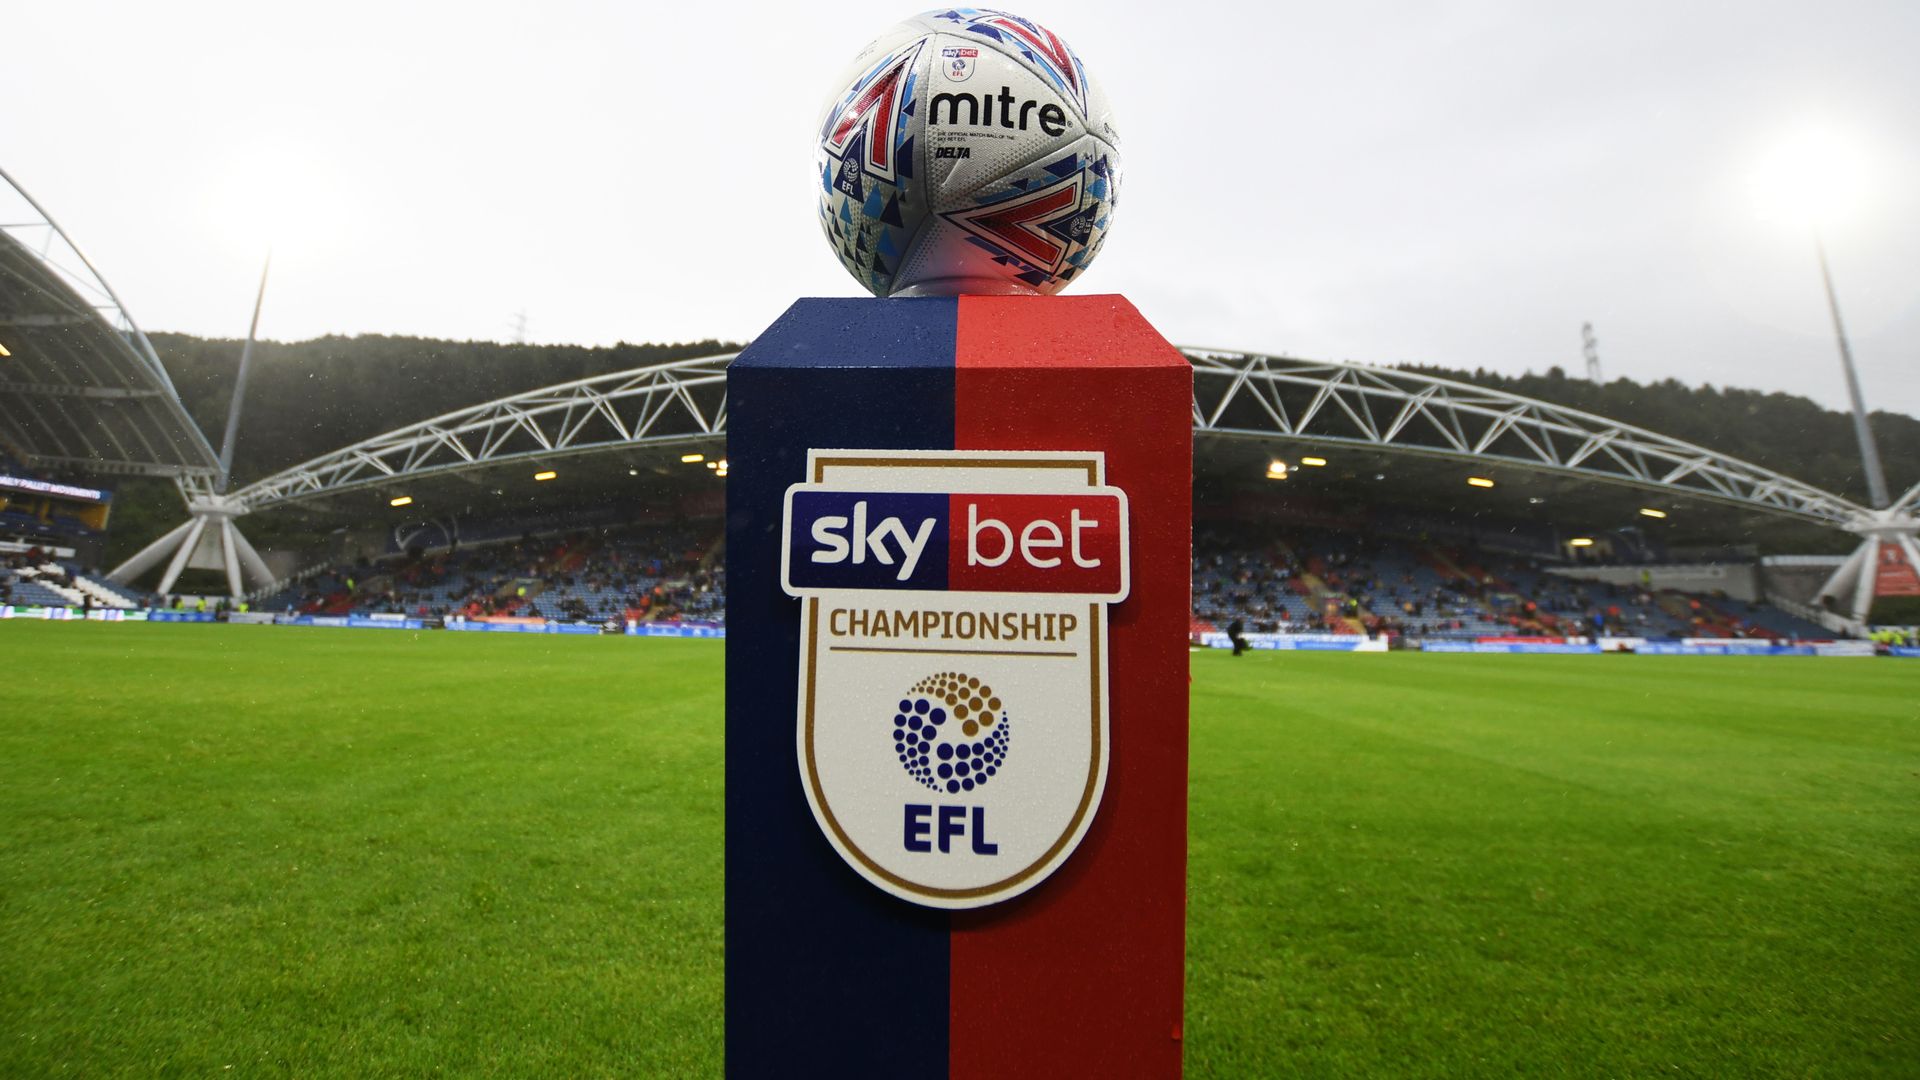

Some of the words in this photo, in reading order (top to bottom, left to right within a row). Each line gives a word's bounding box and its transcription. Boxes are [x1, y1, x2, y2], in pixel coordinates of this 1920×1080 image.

[943, 49, 959, 58] sky
[960, 48, 977, 57] bet
[929, 86, 1066, 137] mitre
[935, 147, 970, 158] DELTA
[842, 180, 854, 195] EFL
[1084, 215, 1094, 234] EFL
[811, 501, 937, 581] sky
[967, 503, 1101, 568] bet
[829, 608, 1077, 641] CHAMPIONSHIP
[904, 804, 998, 856] EFL
